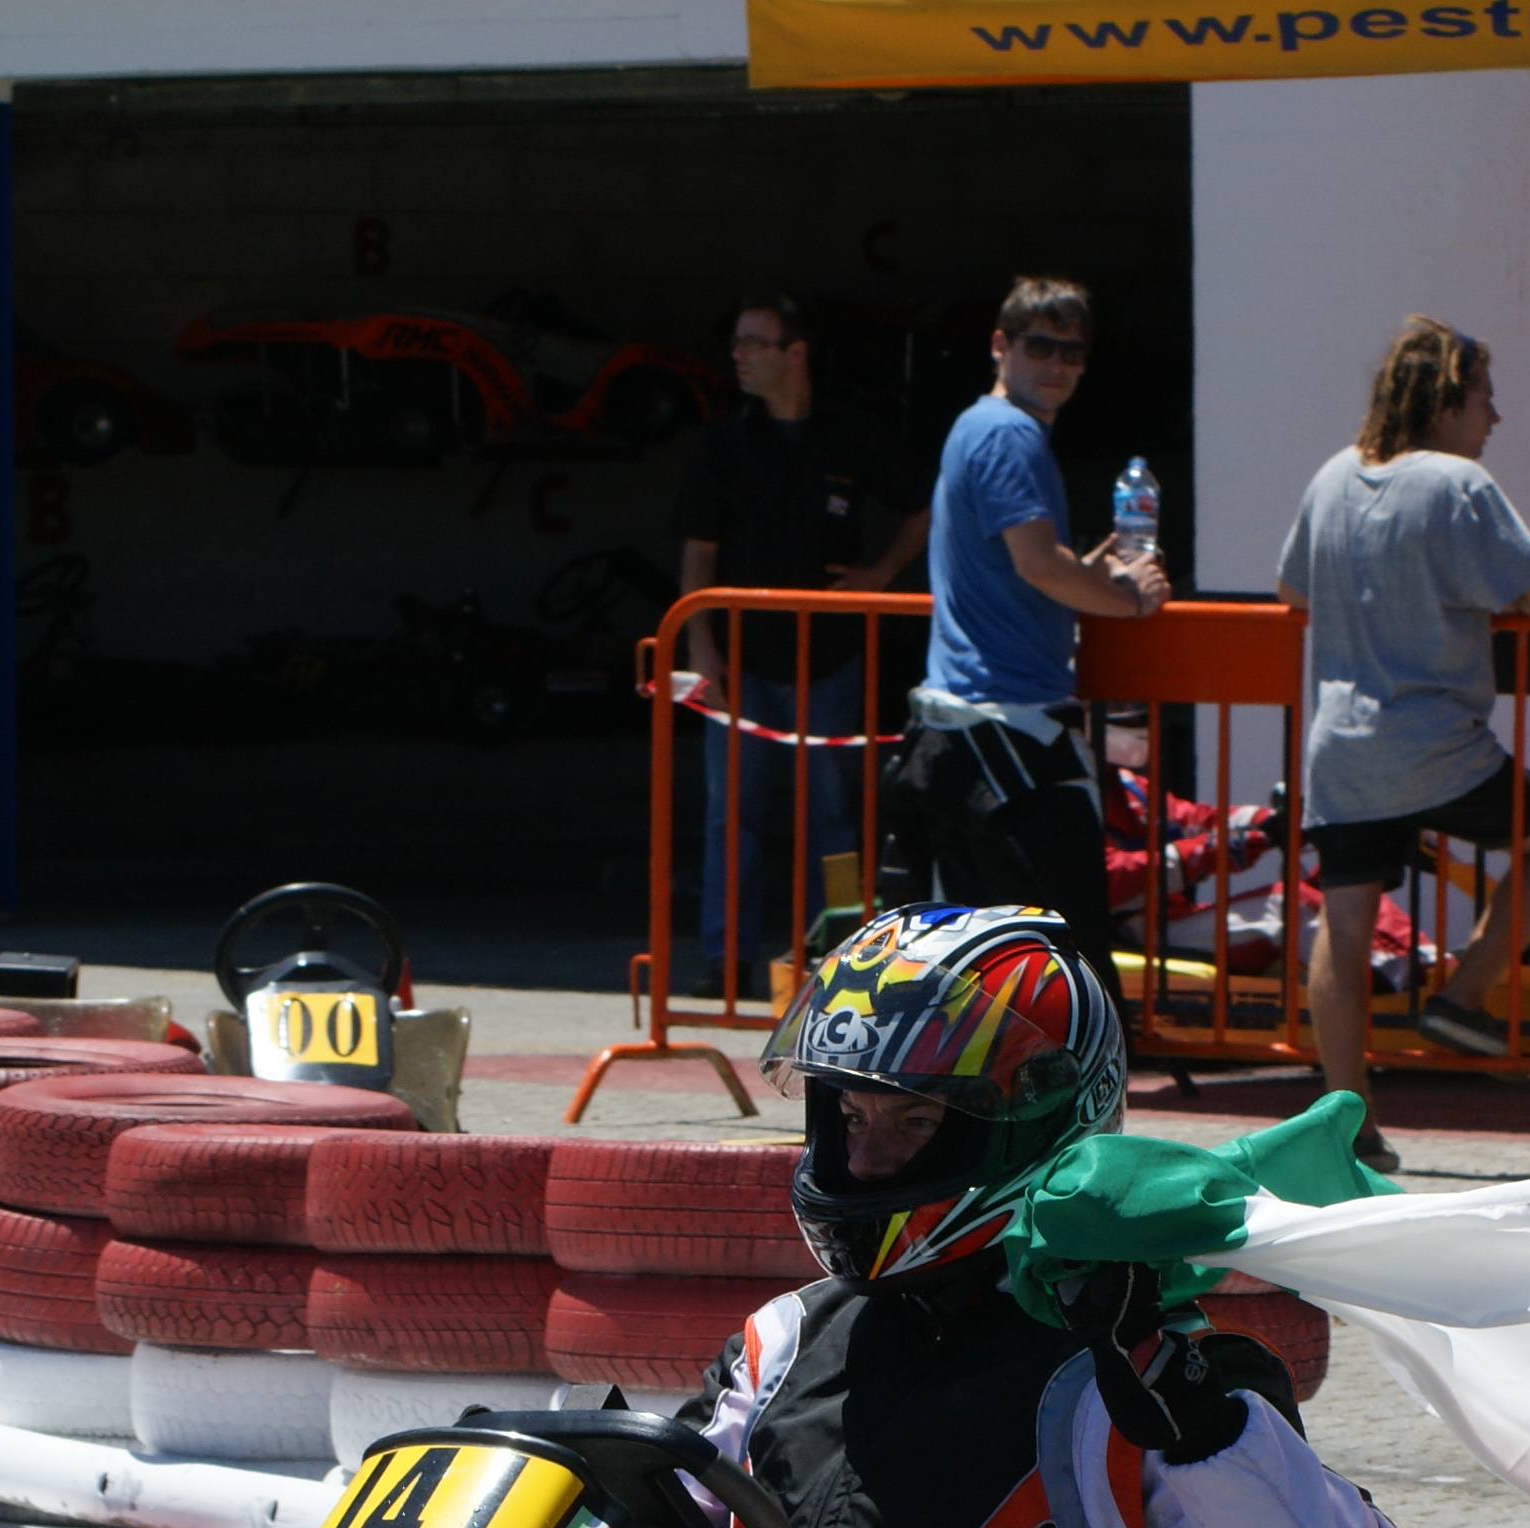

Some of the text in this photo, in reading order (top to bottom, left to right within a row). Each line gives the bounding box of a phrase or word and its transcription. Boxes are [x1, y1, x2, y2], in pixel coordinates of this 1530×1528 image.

[355, 217, 390, 277] B
[862, 220, 898, 273] C
[28, 474, 68, 543] B
[532, 472, 571, 534] C
[278, 997, 361, 1058] 00
